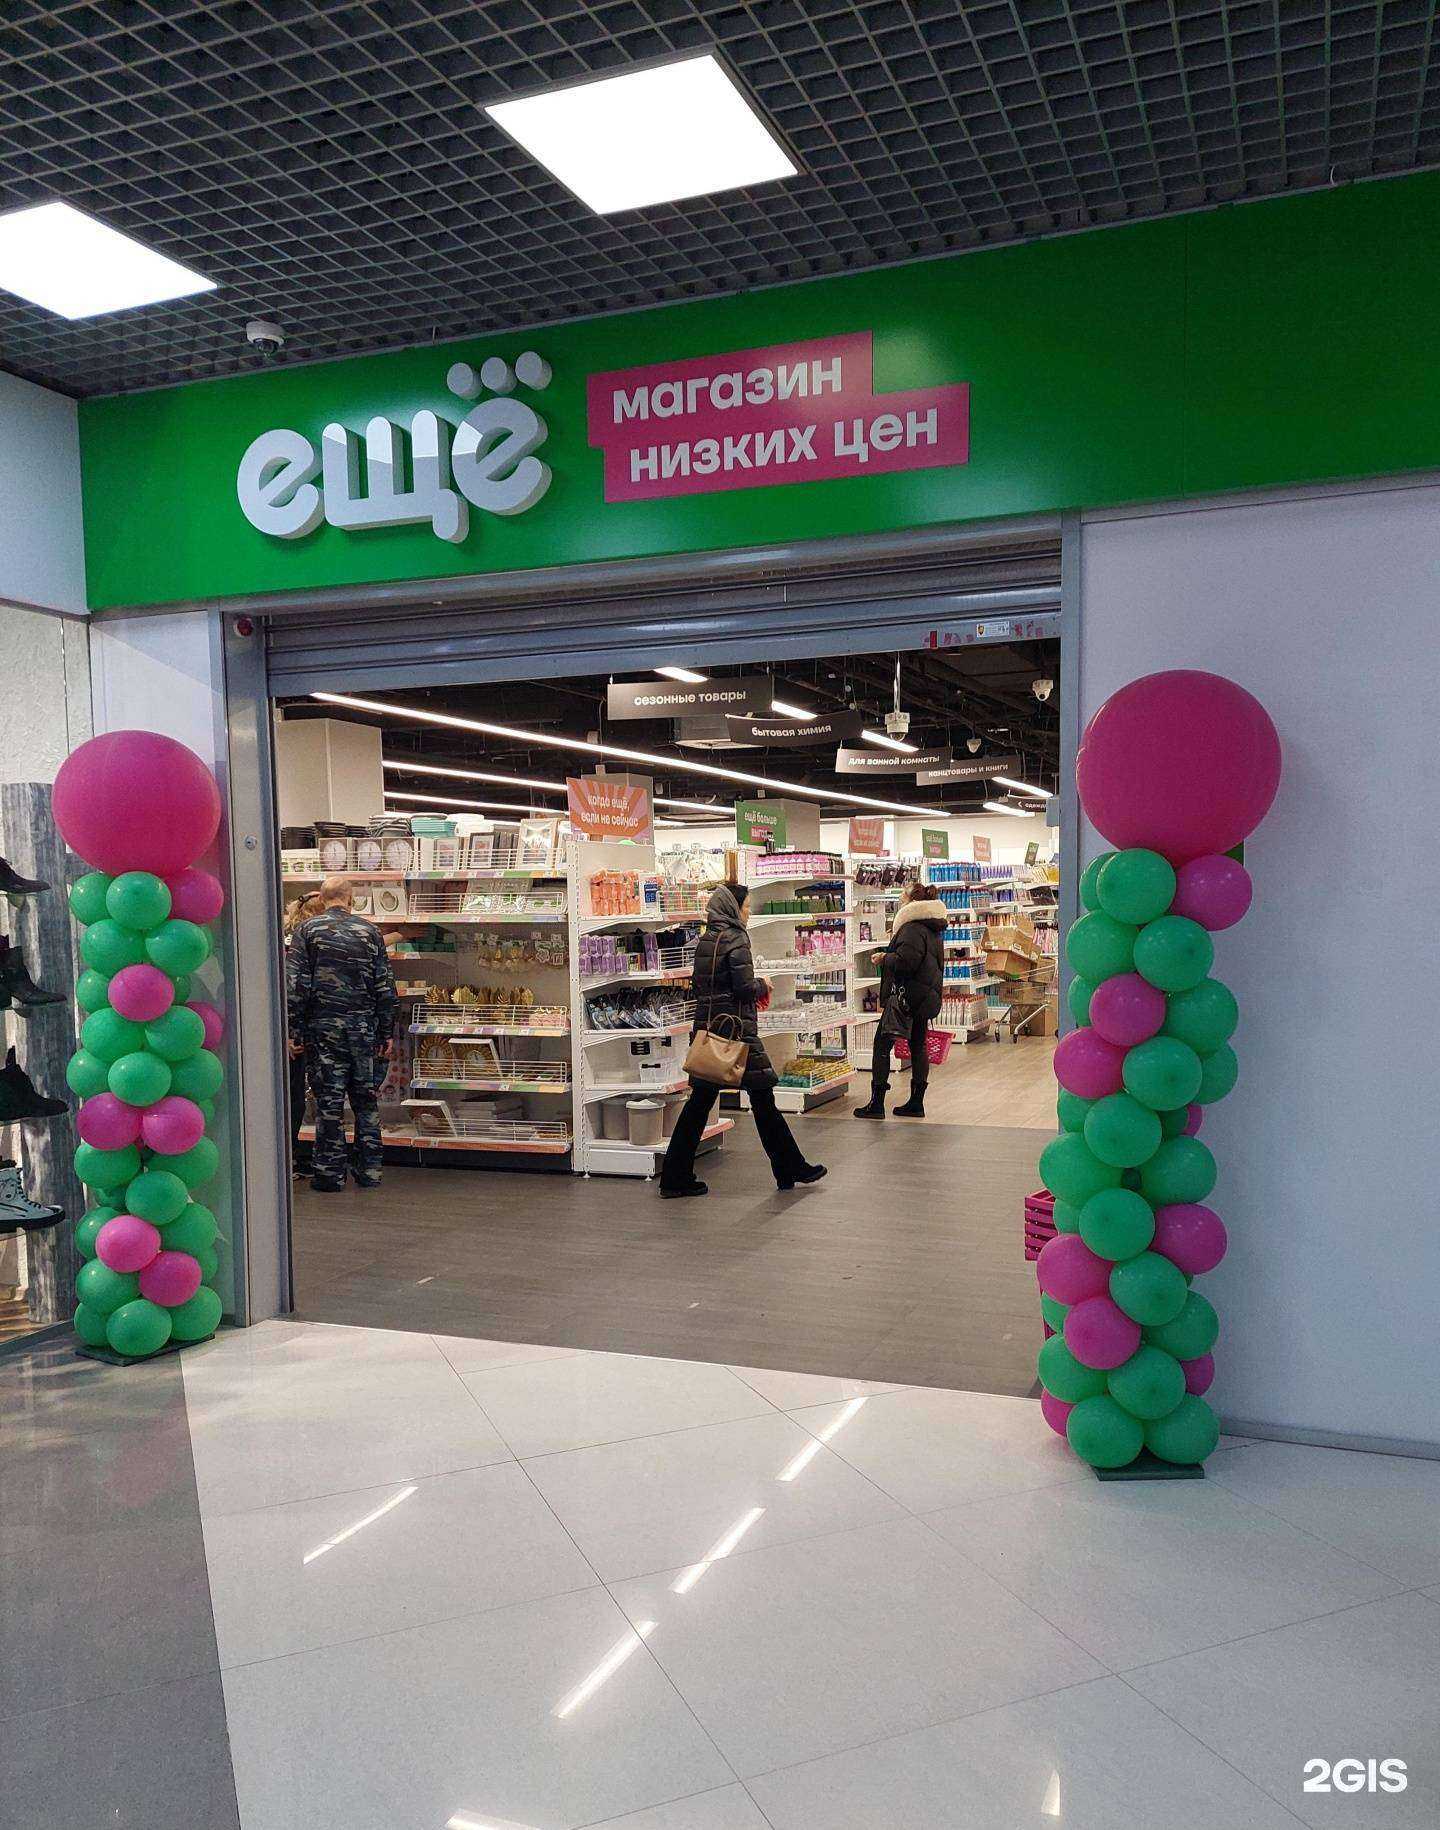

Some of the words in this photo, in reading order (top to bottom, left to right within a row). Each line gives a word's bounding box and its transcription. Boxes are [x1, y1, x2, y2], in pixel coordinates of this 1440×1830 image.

[613, 357, 842, 424] магазин
[237, 351, 552, 543] ещё
[630, 425, 817, 482] низких
[834, 408, 938, 463] цен
[634, 693, 696, 706] сезонные
[699, 690, 746, 703] товары
[752, 727, 796, 737] бытовая
[798, 725, 832, 736] химия
[867, 756, 900, 766] ванной
[901, 755, 940, 765] комнаты
[985, 764, 1009, 772] книги
